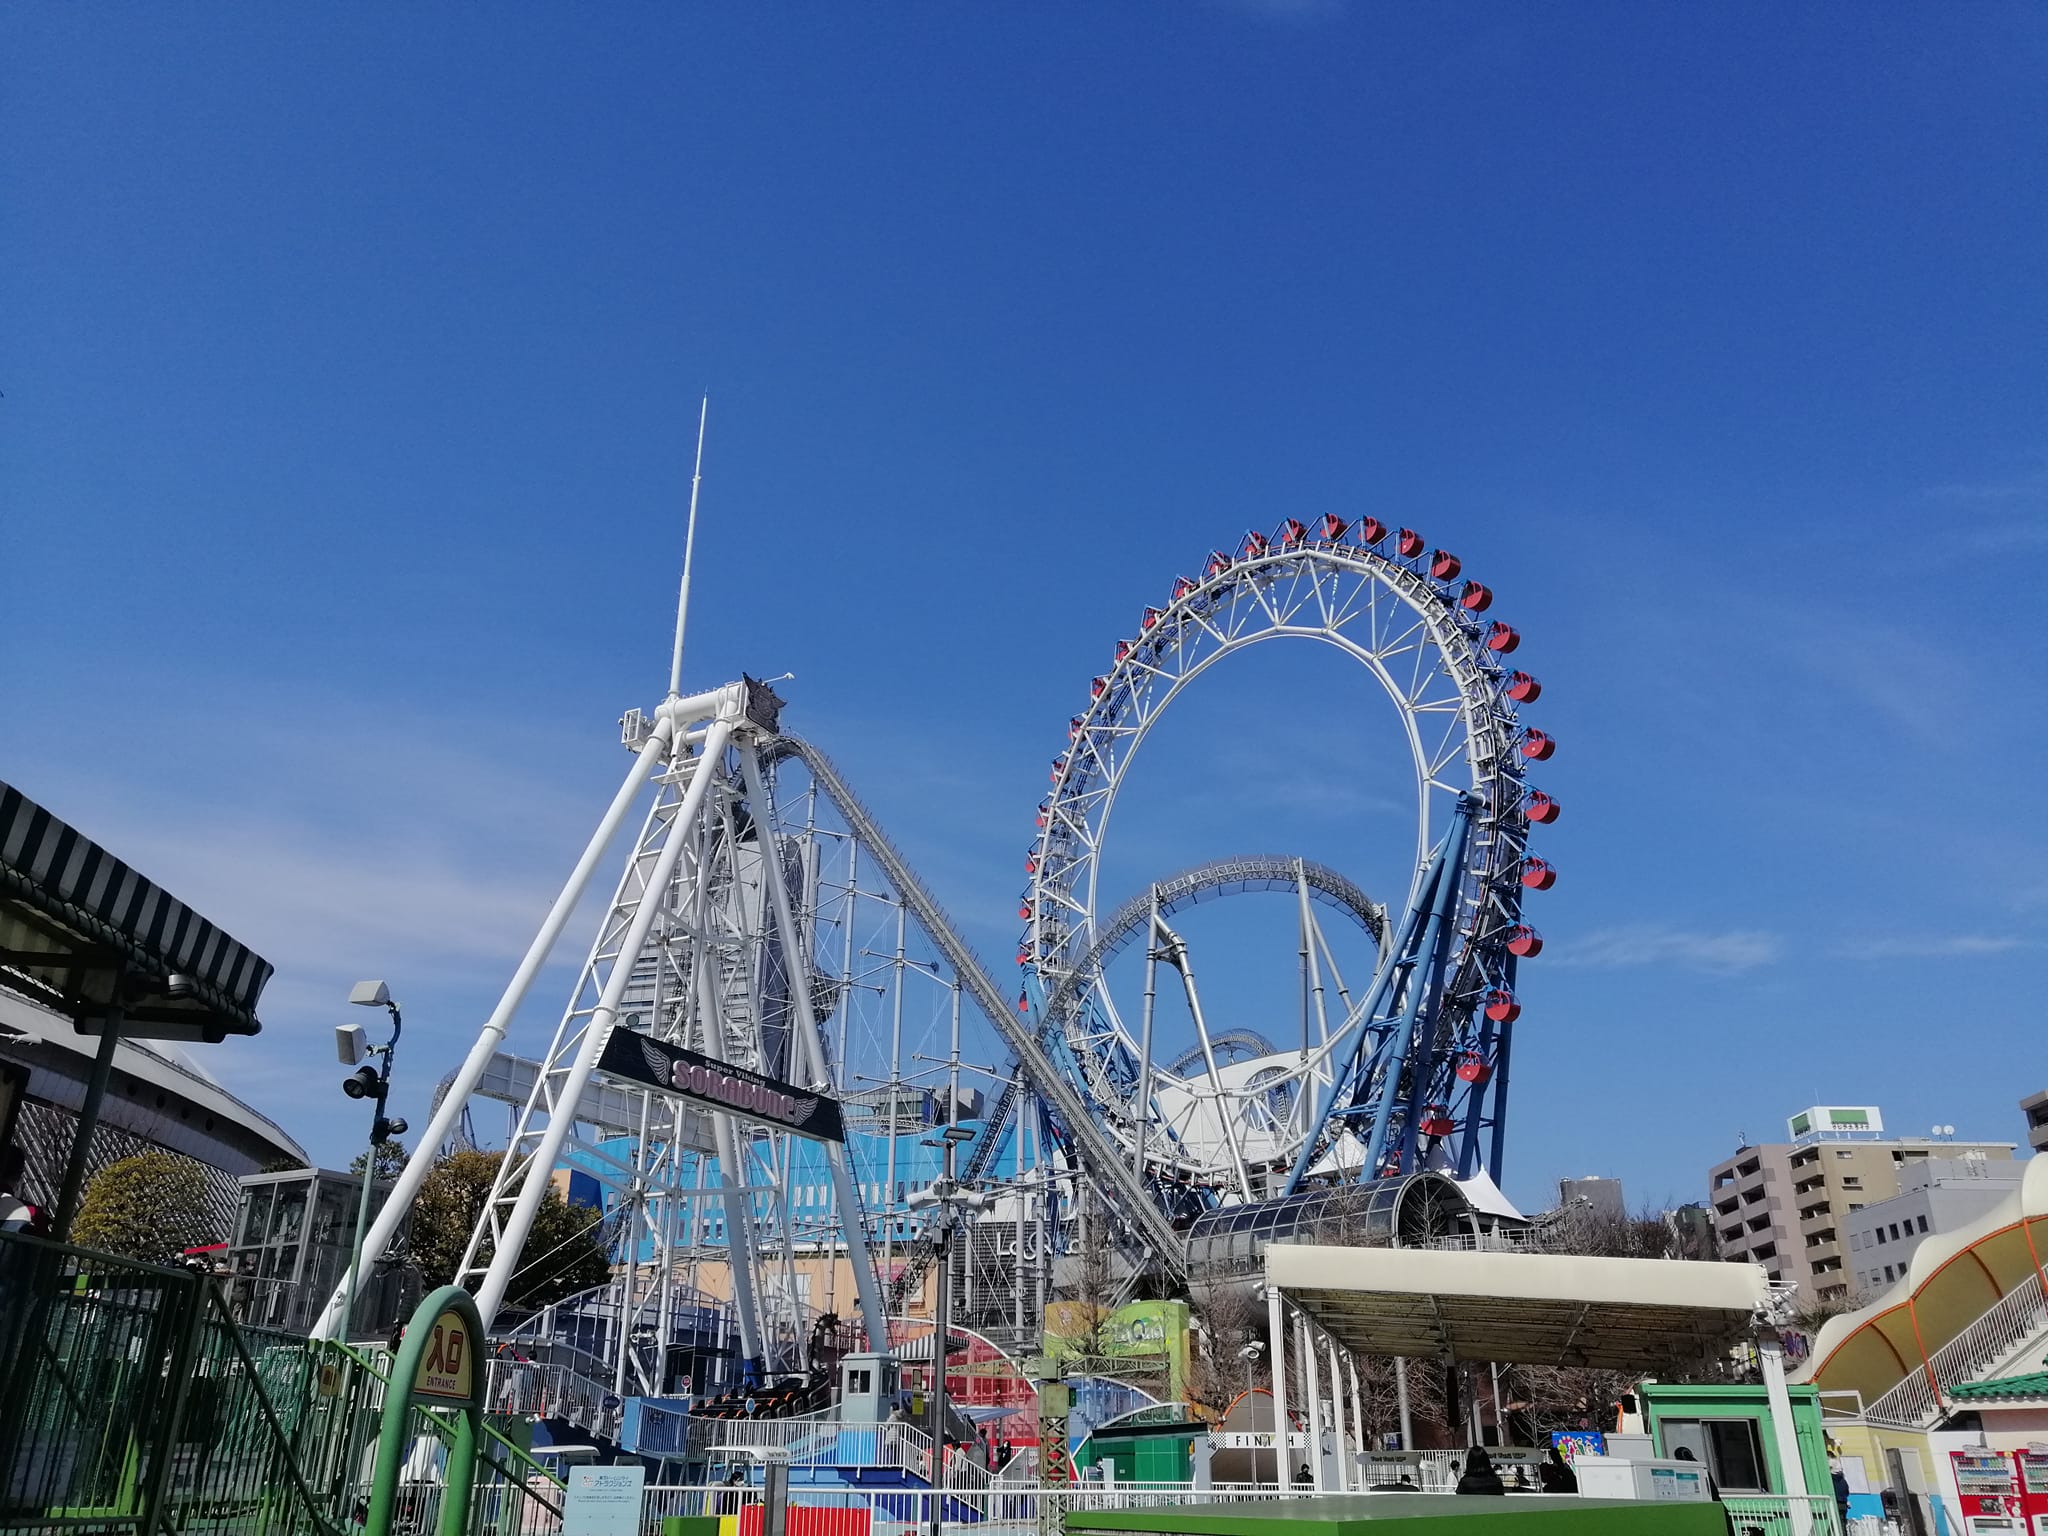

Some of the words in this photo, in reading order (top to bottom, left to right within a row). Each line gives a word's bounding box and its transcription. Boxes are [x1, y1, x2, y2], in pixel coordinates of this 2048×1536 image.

[704, 1059, 736, 1076] Super
[736, 1070, 767, 1088] Viking
[426, 1325, 464, 1375] 入口
[426, 1376, 457, 1390] ENTRANCE
[1236, 1435, 1294, 1447] FINIH
